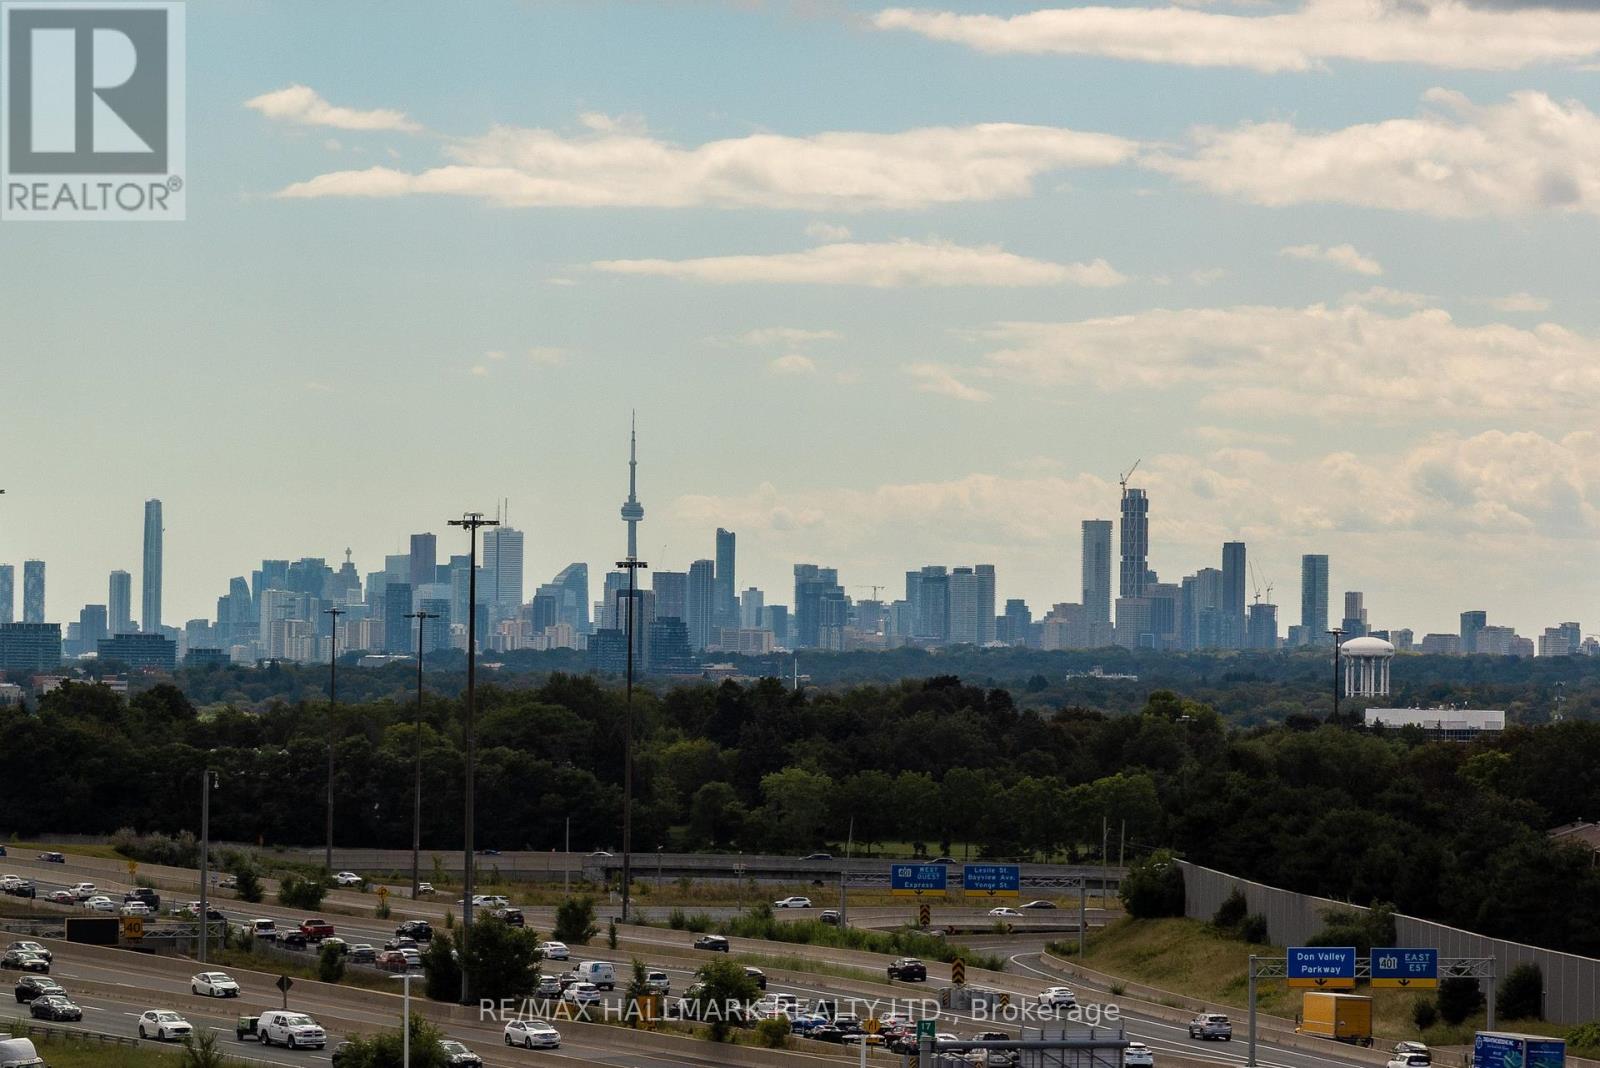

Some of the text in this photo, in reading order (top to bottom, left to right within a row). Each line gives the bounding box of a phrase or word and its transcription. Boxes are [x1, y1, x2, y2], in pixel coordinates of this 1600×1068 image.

[974, 881, 996, 889] Yonge
[126, 922, 141, 932] 40
[1297, 952, 1346, 962] Don Valley
[1404, 953, 1430, 961] EAST
[1380, 957, 1397, 969] 401
[1301, 965, 1341, 974] Parkway
[1409, 964, 1427, 972] EST
[921, 1022, 932, 1030] 17
